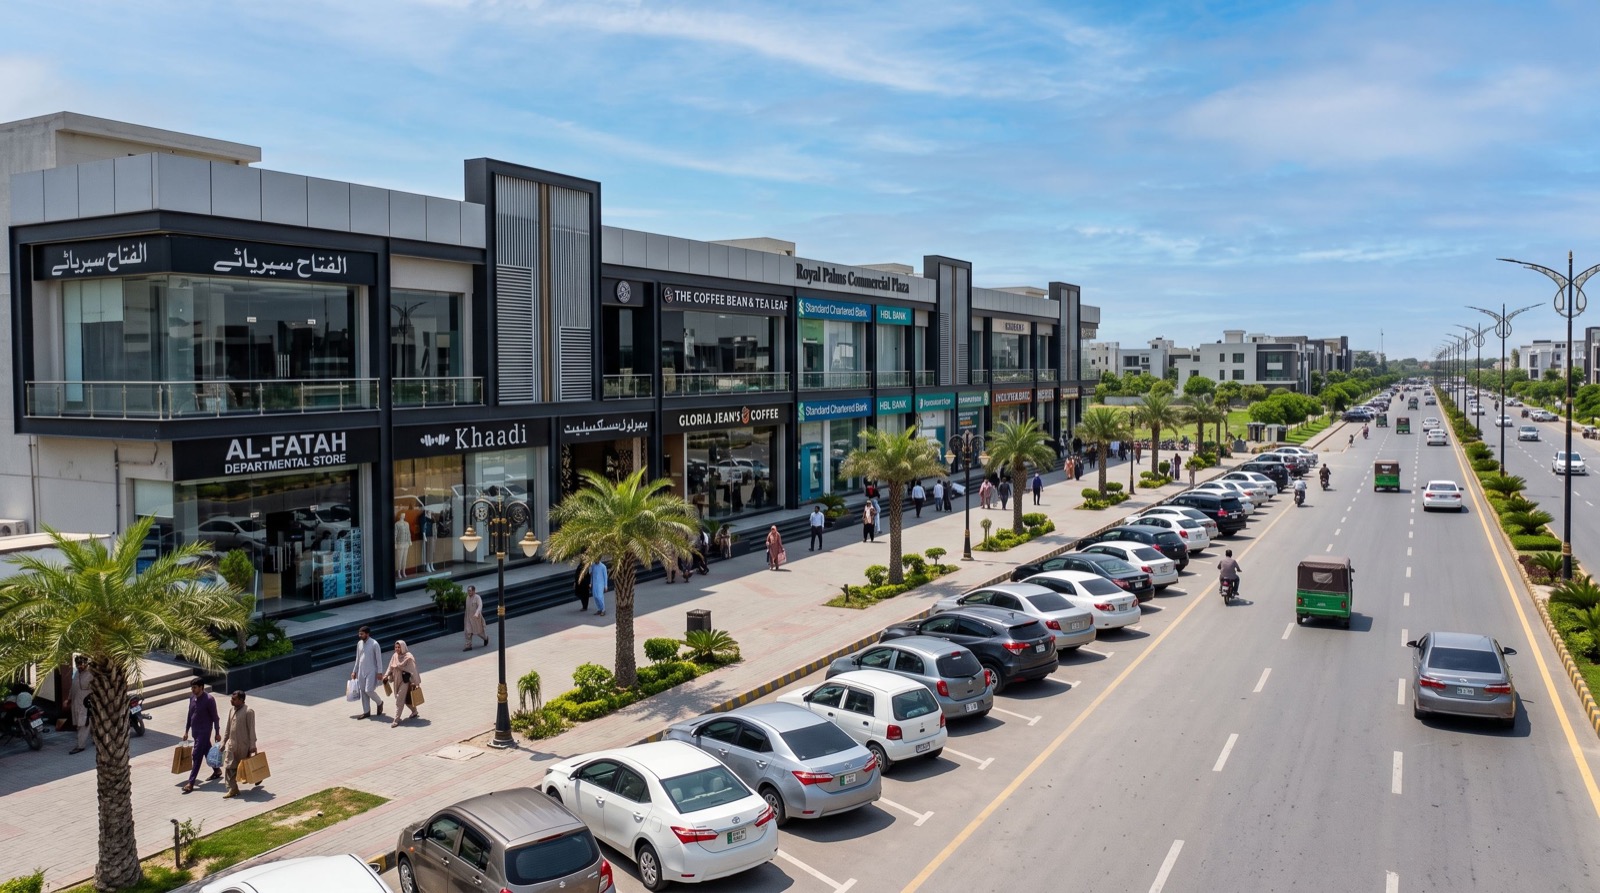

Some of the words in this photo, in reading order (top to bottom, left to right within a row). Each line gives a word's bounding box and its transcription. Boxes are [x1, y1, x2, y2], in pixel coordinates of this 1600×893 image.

[796, 263, 821, 285] Royal
[823, 267, 847, 285] Palms
[847, 271, 891, 291] Commercial
[891, 277, 910, 294] Plaza
[674, 290, 692, 302] THE
[693, 292, 725, 305] COFFEE
[726, 295, 748, 307] BEAN
[748, 297, 754, 308] &
[755, 298, 770, 309] TEA
[770, 299, 788, 311] LEAF
[805, 302, 830, 314] Standard
[829, 304, 855, 317] Chartered
[880, 310, 892, 320] HBL
[892, 311, 907, 321] BANK
[805, 403, 830, 416] Standard
[830, 404, 855, 414] Chartered
[855, 402, 868, 412] Bank
[879, 401, 891, 411] HBL
[892, 400, 907, 410] BANK
[679, 413, 712, 427] GLORIA
[713, 411, 741, 424] JEAN'S
[750, 408, 779, 421] COFFEE
[225, 431, 347, 461] AL-FATAH
[454, 423, 527, 450] Khaadi
[224, 457, 311, 474] DEPARTMENTAL
[313, 453, 347, 467] STORE
